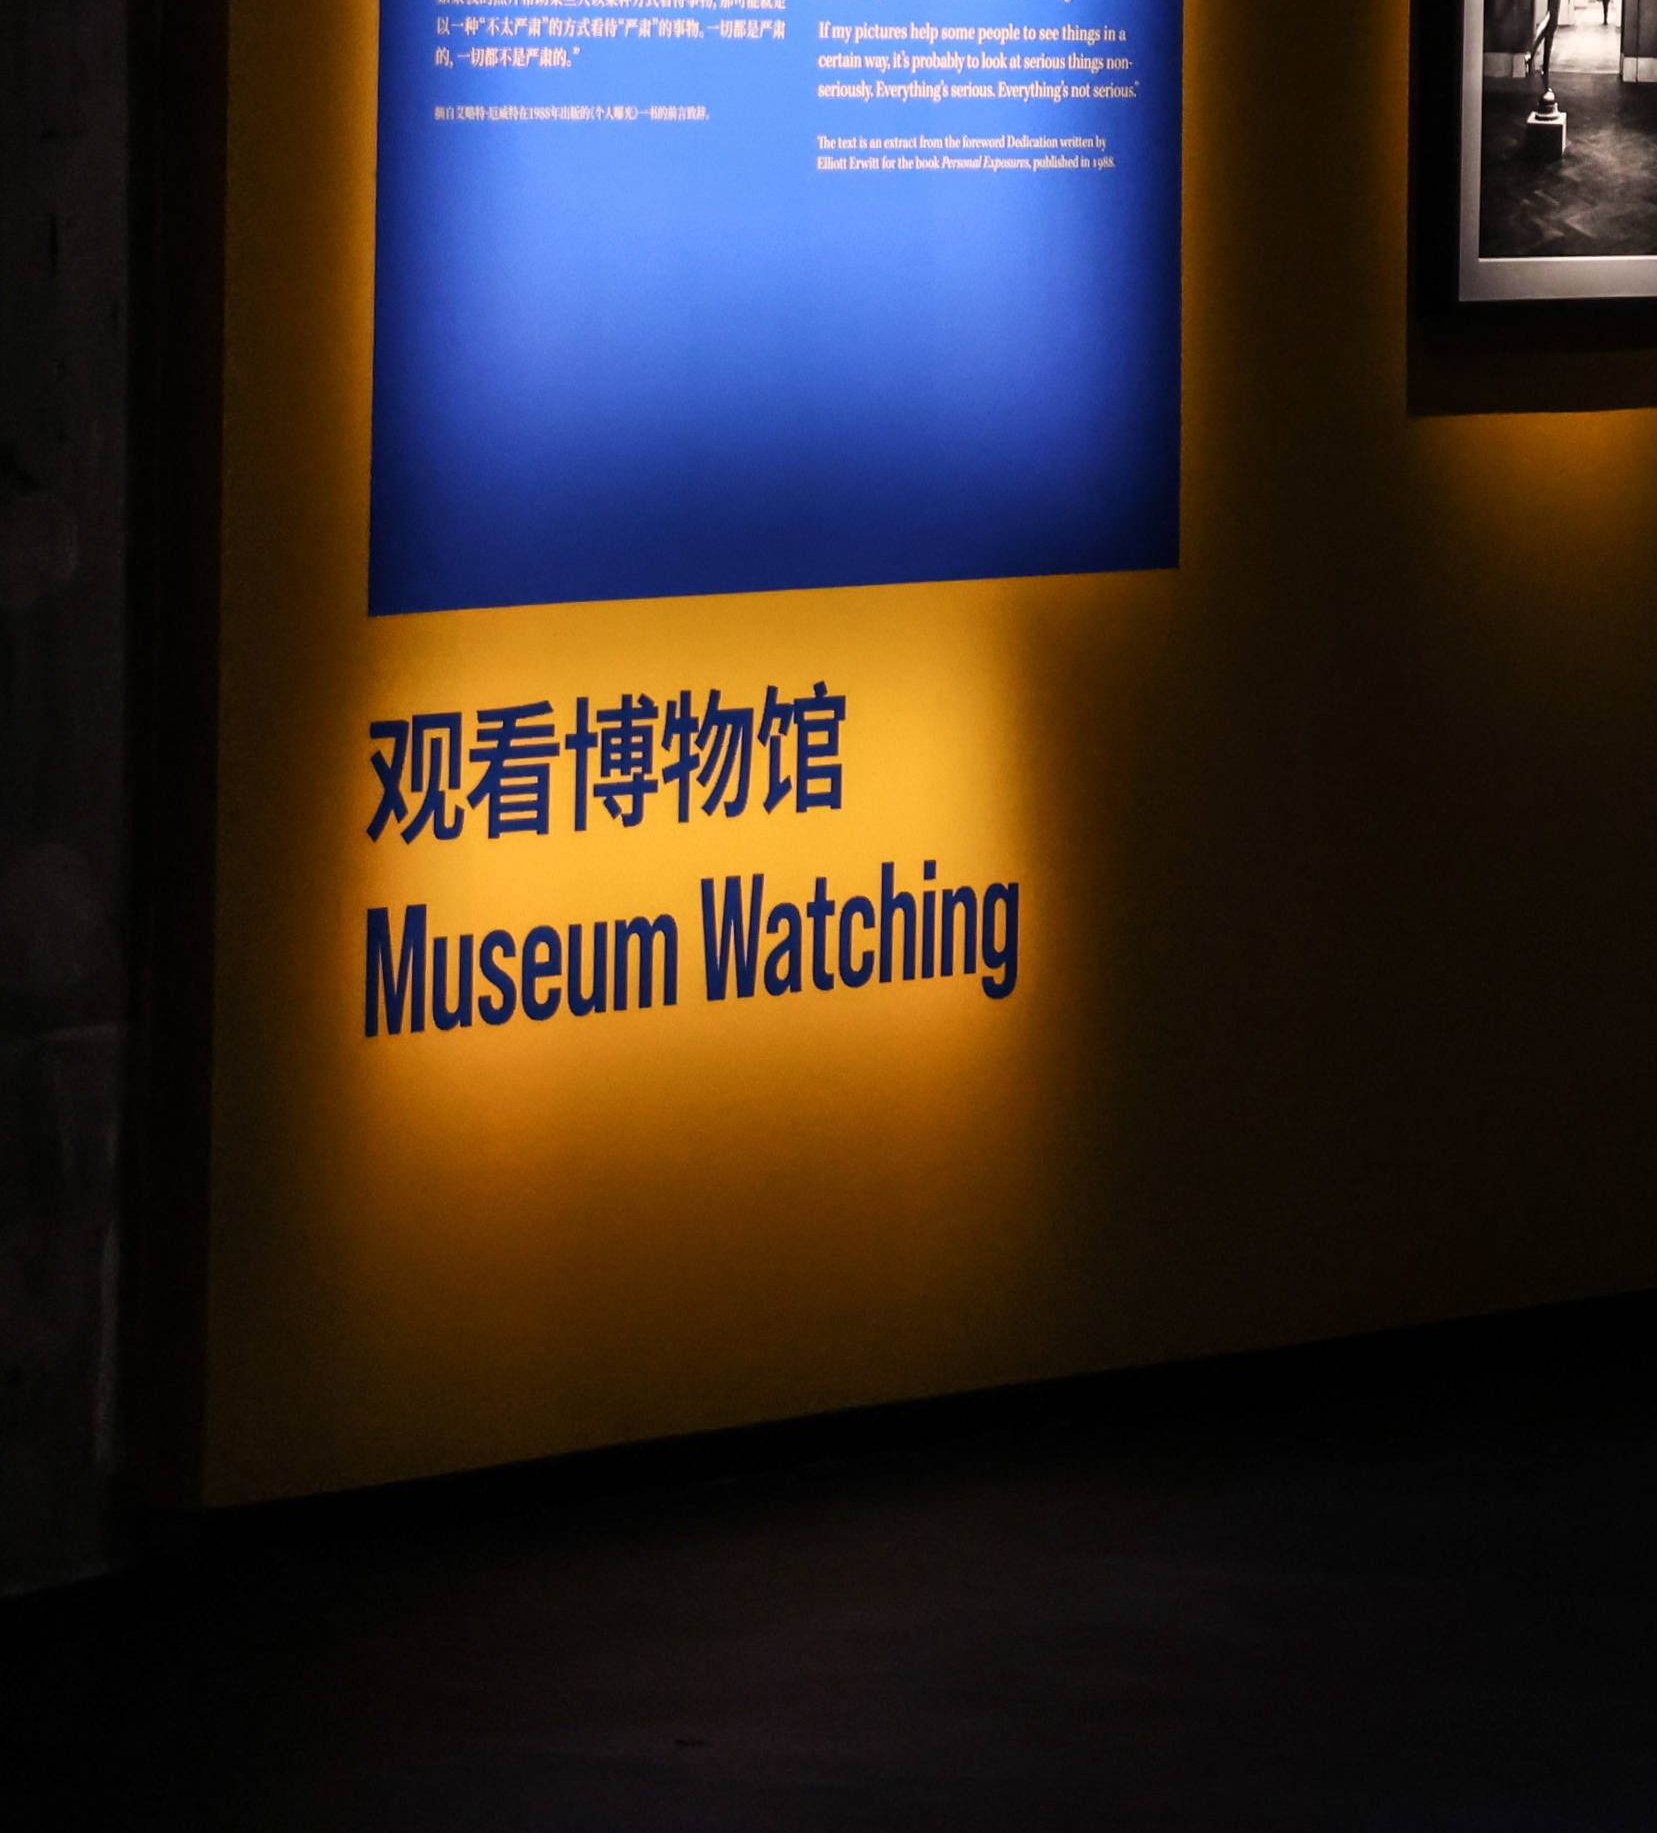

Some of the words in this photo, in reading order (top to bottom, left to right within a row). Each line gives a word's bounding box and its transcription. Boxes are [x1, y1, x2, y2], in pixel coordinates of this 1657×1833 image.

[819, 21, 831, 39] If
[832, 26, 852, 44] my
[854, 23, 908, 44] pictures
[910, 22, 939, 45] help
[940, 27, 976, 40] some
[977, 23, 1021, 45] people
[1023, 26, 1037, 41] to
[1039, 28, 1060, 41] see
[1062, 24, 1101, 46] things
[1104, 25, 1116, 41] in
[1119, 30, 1126, 41] a
[818, 52, 862, 69] certain
[864, 56, 891, 73] way,
[911, 51, 966, 74] probably
[966, 54, 980, 69] to
[981, 52, 1008, 69] look
[1009, 54, 1022, 69] at
[1024, 53, 1066, 70] serious
[1068, 53, 1104, 74] things
[1106, 58, 1133, 70] non-
[818, 80, 874, 102] seriously.
[950, 82, 996, 98] serious.
[1071, 84, 1090, 98] not
[366, 680, 847, 844] 观看博物馆
[365, 904, 678, 1038] Museum
[701, 859, 1019, 1000] Watching
